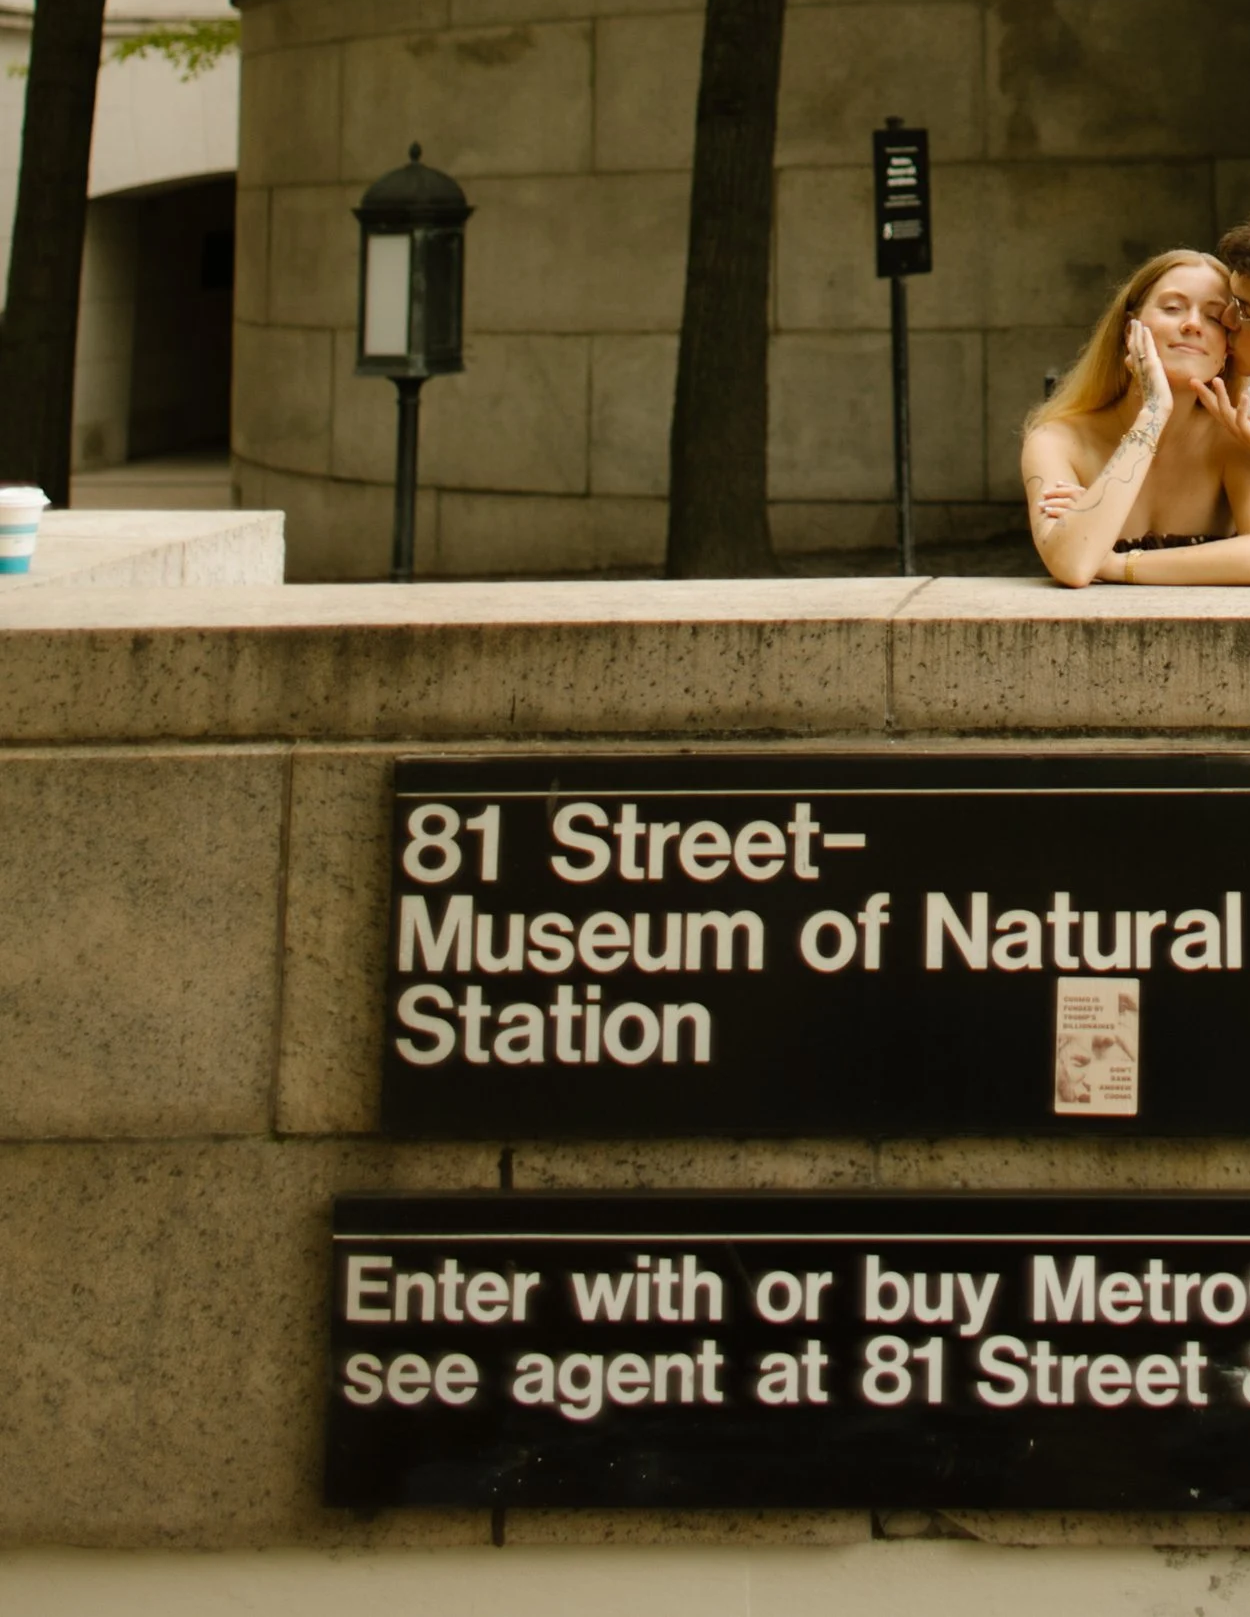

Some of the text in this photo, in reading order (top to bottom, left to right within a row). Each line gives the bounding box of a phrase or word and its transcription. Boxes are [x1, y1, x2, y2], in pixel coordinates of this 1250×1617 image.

[402, 801, 867, 883] 81 Street-
[397, 894, 765, 973] Museum
[799, 891, 891, 973] of
[925, 890, 1243, 972] Natural
[395, 983, 712, 1066] Station
[1062, 1022, 1115, 1030] BILLIONAIRES
[345, 1254, 541, 1323] Enter
[570, 1253, 724, 1323] with
[755, 1269, 834, 1324] or
[864, 1253, 1001, 1338] buy
[343, 1352, 480, 1406] see
[511, 1338, 725, 1422] agent
[755, 1338, 830, 1405] at
[861, 1334, 944, 1407] 81
[975, 1334, 1209, 1408] Street
